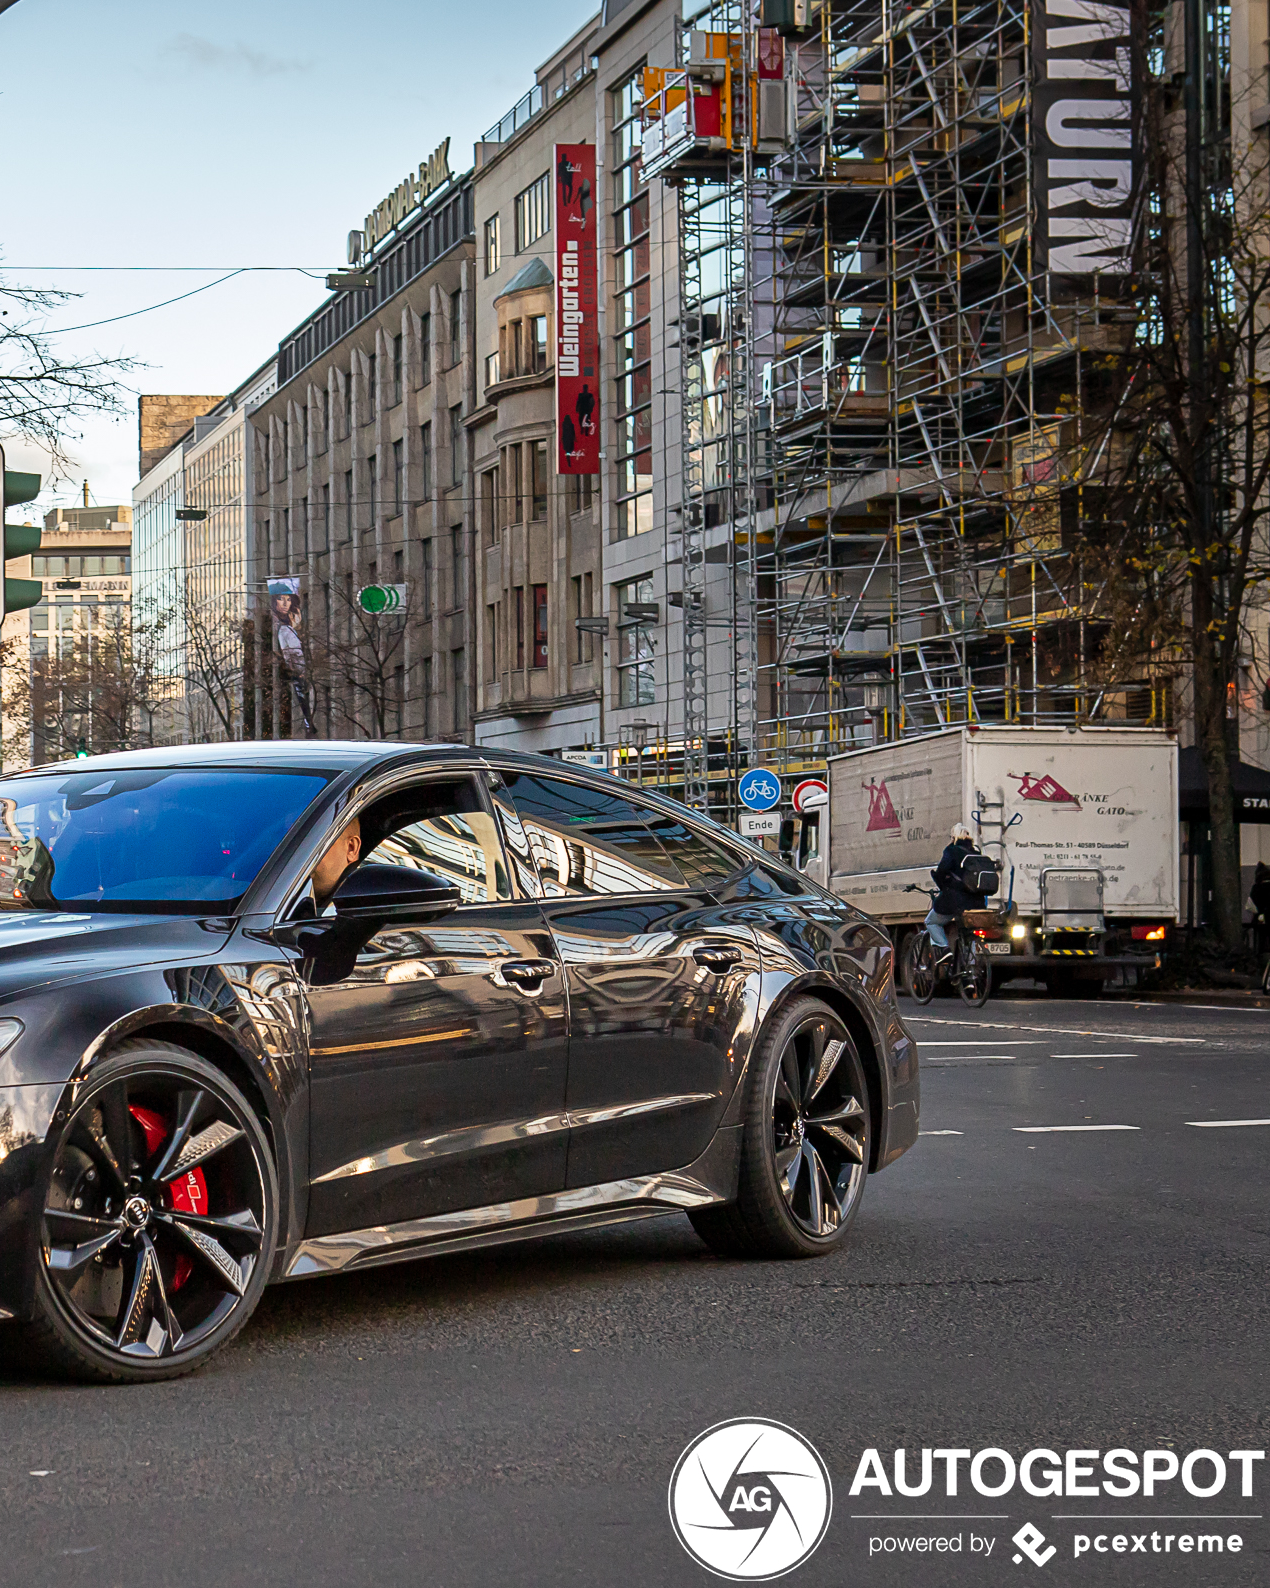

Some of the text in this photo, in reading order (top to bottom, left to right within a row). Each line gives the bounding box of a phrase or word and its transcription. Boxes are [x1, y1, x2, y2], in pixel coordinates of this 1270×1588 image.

[559, 253, 584, 377] Weingarten
[1097, 806, 1126, 815] GATO
[748, 820, 774, 831] Ende
